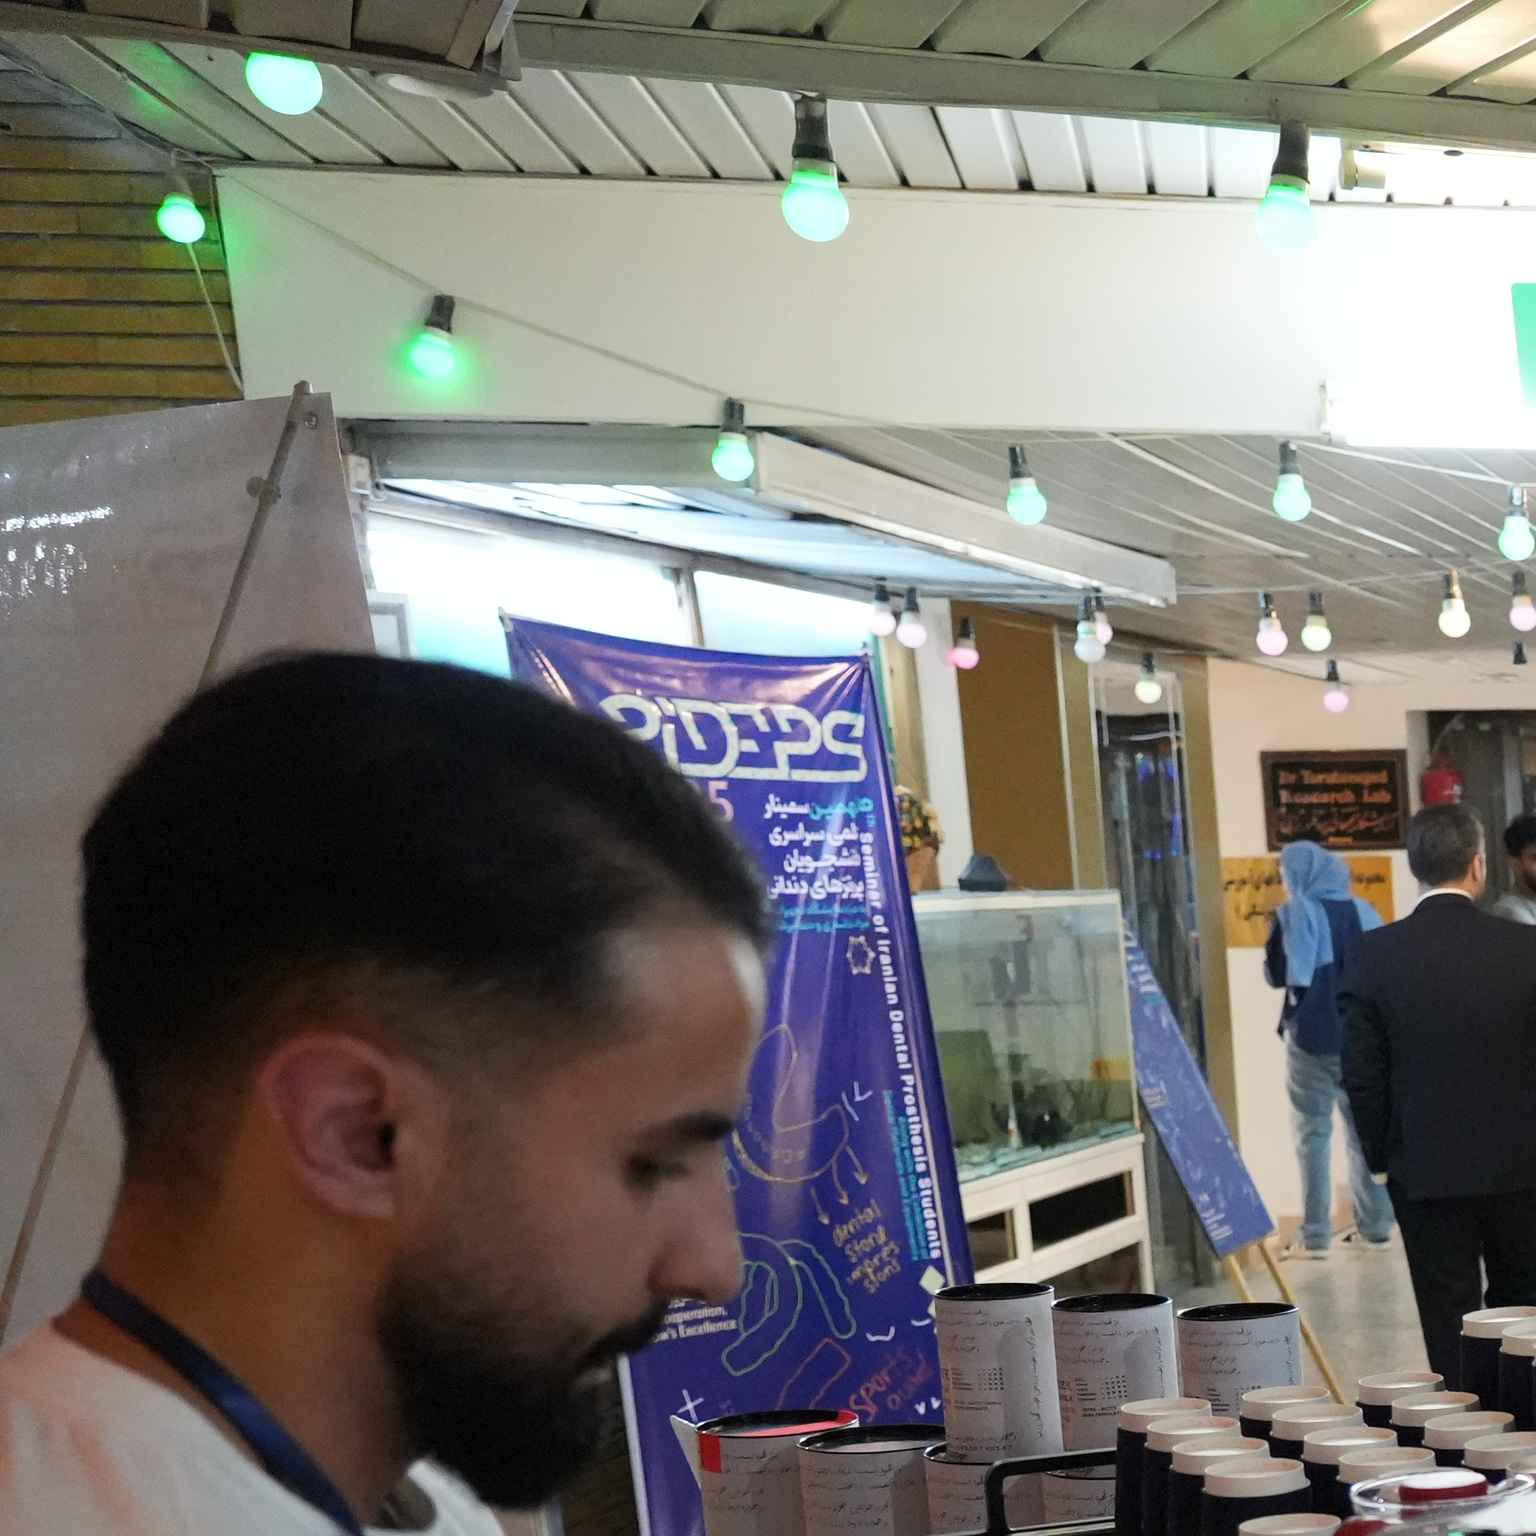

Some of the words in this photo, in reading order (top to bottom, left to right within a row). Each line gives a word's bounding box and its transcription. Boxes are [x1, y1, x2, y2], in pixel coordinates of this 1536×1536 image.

[872, 914, 890, 934] of
[877, 939, 899, 1005] Iranian
[889, 1010, 912, 1069] Dental
[900, 1073, 929, 1173] Prosthesis
[917, 1177, 942, 1259] Students
